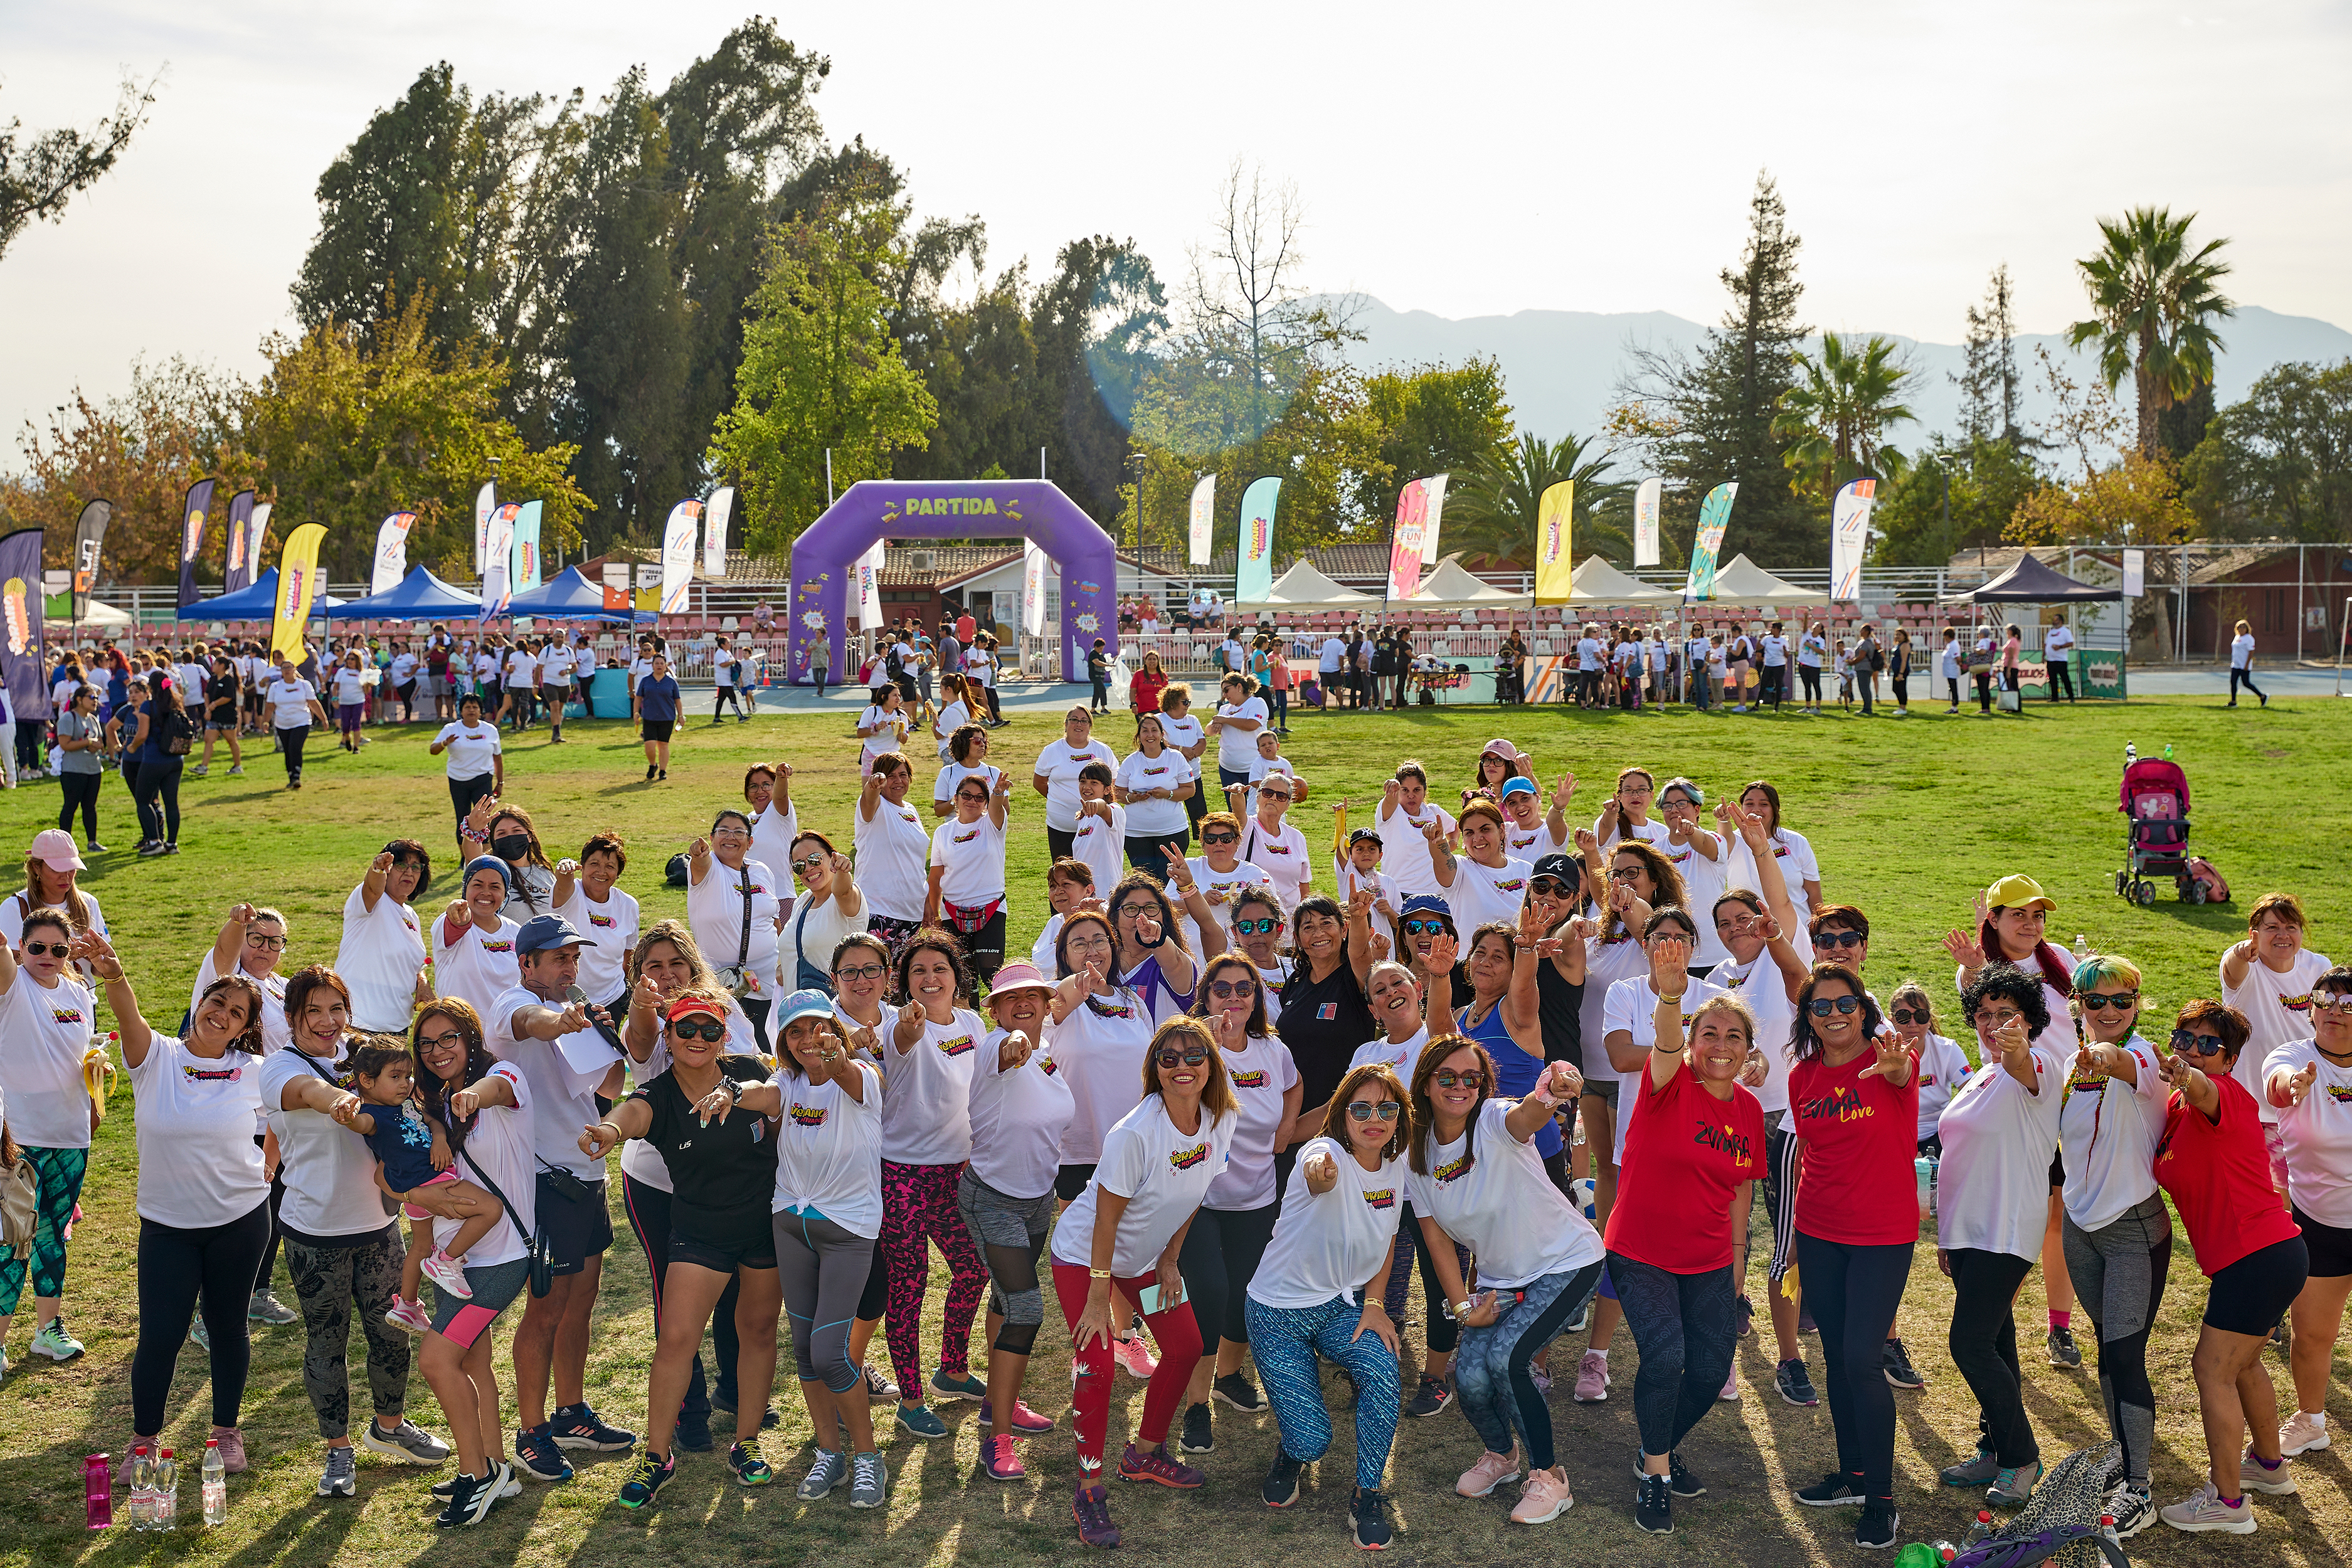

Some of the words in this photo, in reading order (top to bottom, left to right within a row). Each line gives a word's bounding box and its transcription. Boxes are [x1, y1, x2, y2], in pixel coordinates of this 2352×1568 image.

[906, 497, 998, 516] PARTIDA
[1251, 519, 1259, 561] VERANO
[1401, 532, 1421, 541] FUN
[1703, 535, 1723, 544] FUN
[1361, 828, 1373, 836] NY
[788, 995, 813, 1010] Lee
[938, 1036, 970, 1051] VERANO
[1801, 1089, 1863, 1121] ZUMBA
[1840, 1106, 1875, 1123] Love
[1694, 1121, 1752, 1158] ZUMBA
